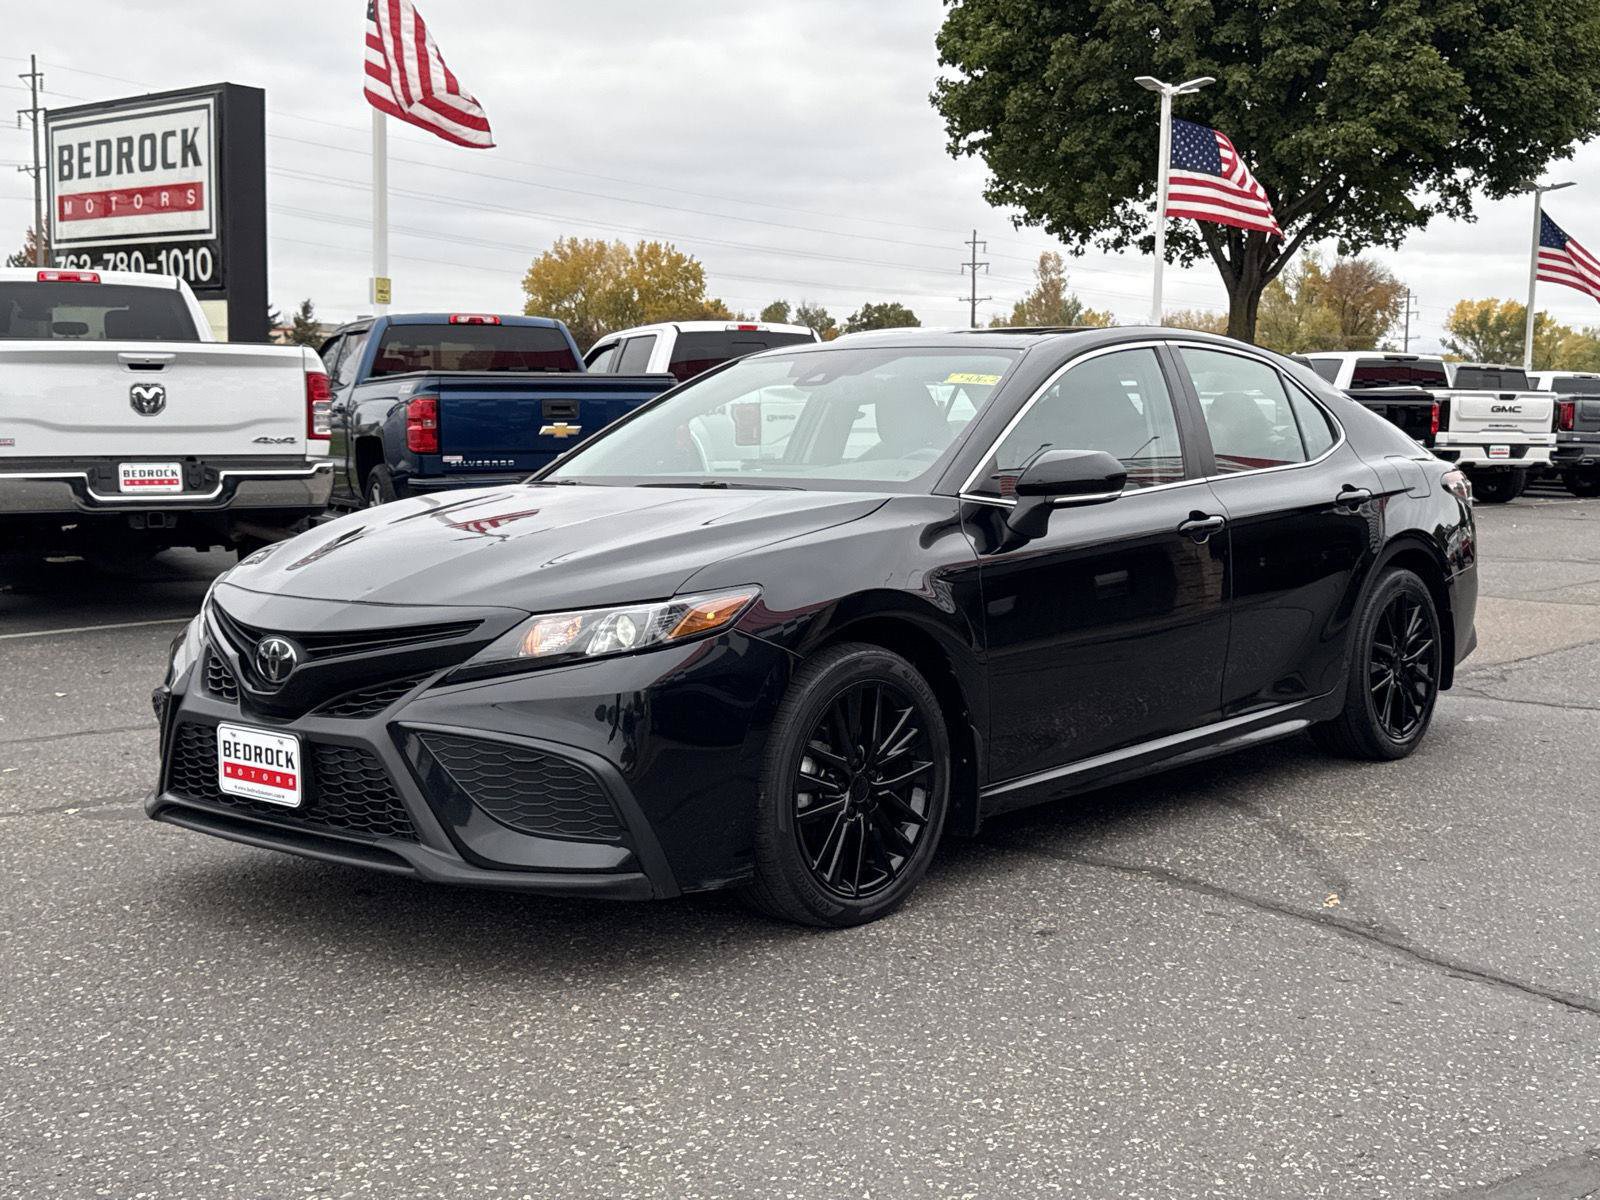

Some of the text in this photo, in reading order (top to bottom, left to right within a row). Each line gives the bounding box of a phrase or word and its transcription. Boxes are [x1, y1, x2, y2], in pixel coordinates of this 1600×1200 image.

[57, 126, 203, 182] BEDROCK
[63, 188, 196, 216] MOTORS
[1491, 405, 1522, 413] GMC
[123, 468, 179, 478] BEDROCK
[222, 739, 296, 770] BEDROCK
[225, 765, 294, 787] MOTORS
